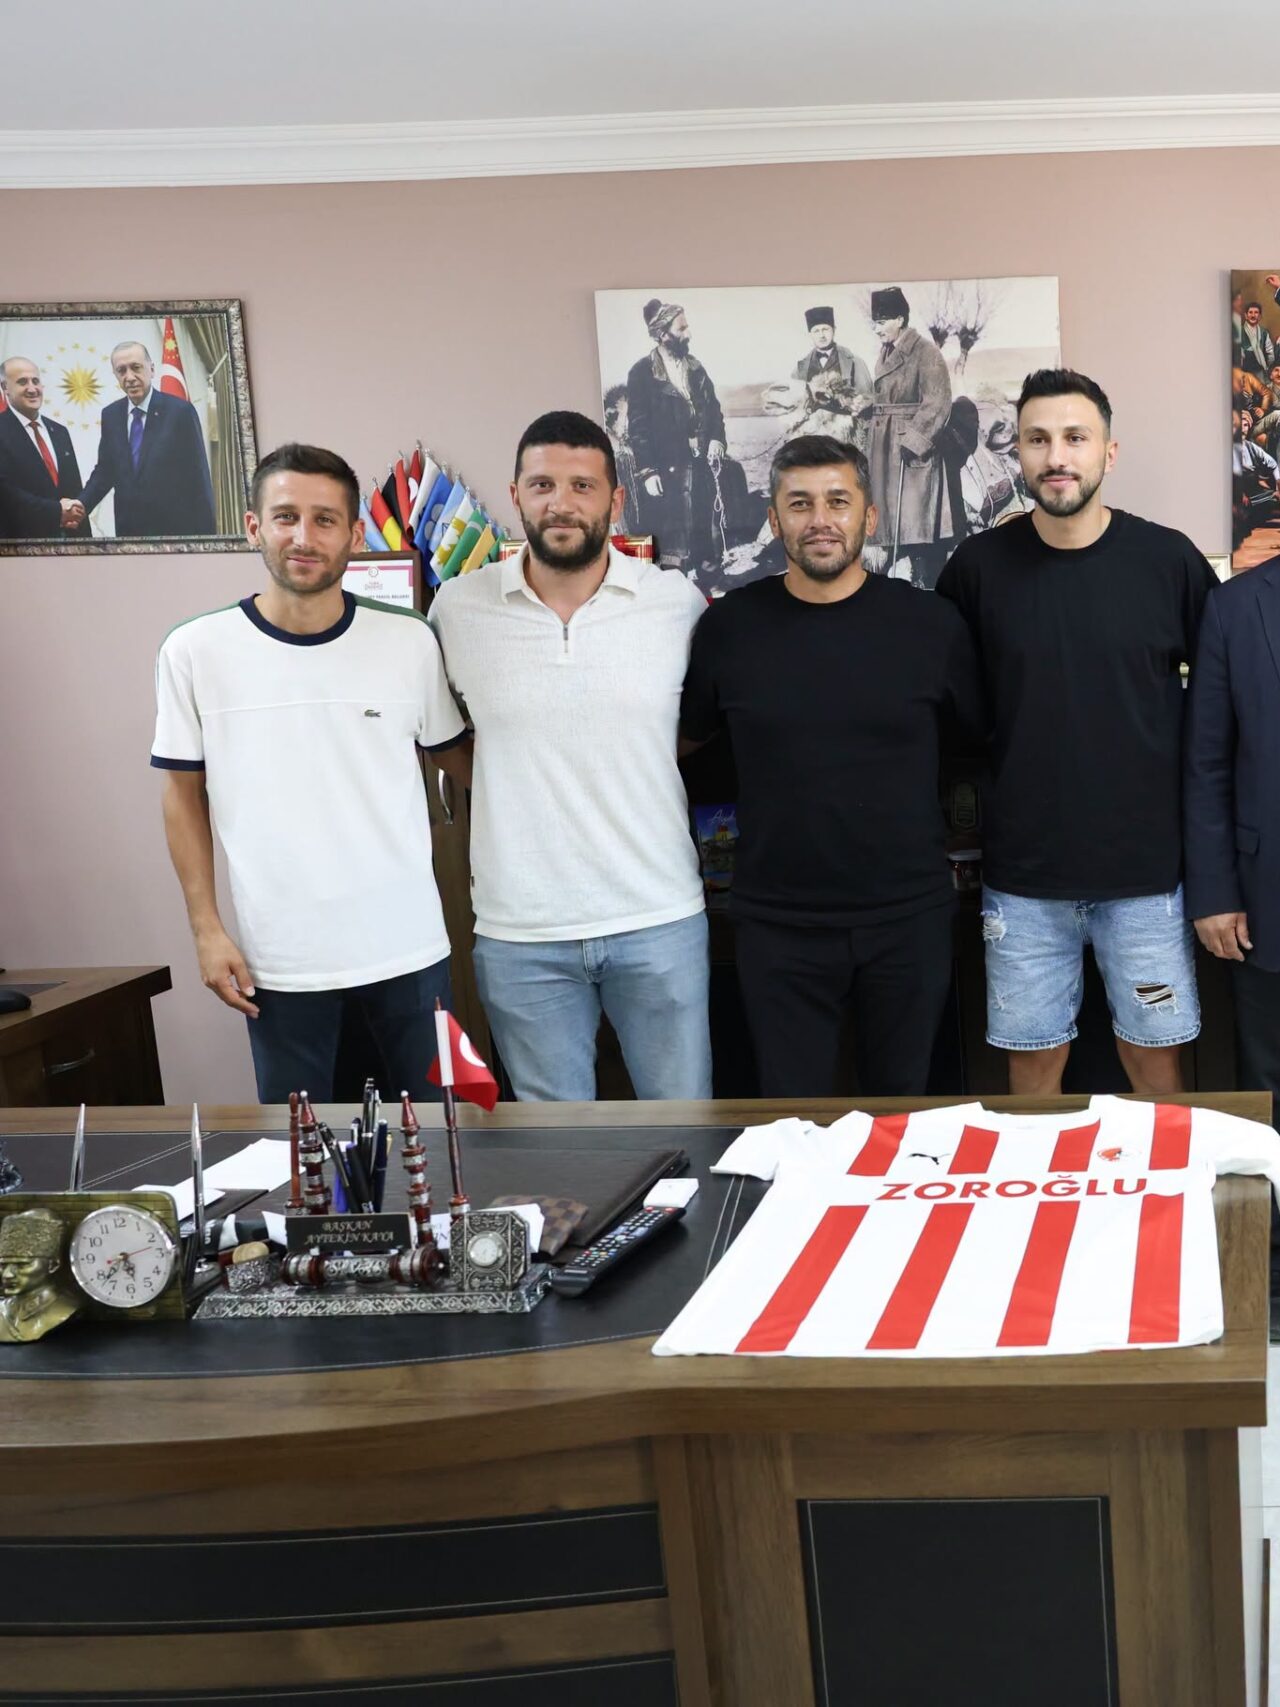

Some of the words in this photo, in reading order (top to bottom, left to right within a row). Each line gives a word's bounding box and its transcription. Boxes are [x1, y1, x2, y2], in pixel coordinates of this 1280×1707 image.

[875, 1174, 1147, 1201] ZOROĞLU
[113, 1217, 127, 1229] 12
[136, 1221, 141, 1232] 1
[322, 1219, 373, 1233] BAŞKAN
[100, 1224, 110, 1235] 11
[89, 1237, 103, 1248] 10
[147, 1233, 156, 1243] 2
[86, 1253, 96, 1264] 9
[155, 1247, 165, 1259] 3
[97, 1269, 106, 1281] 8
[152, 1265, 162, 1276] 4
[109, 1280, 118, 1291] 7
[143, 1277, 153, 1288] 5
[126, 1284, 136, 1295] 6
